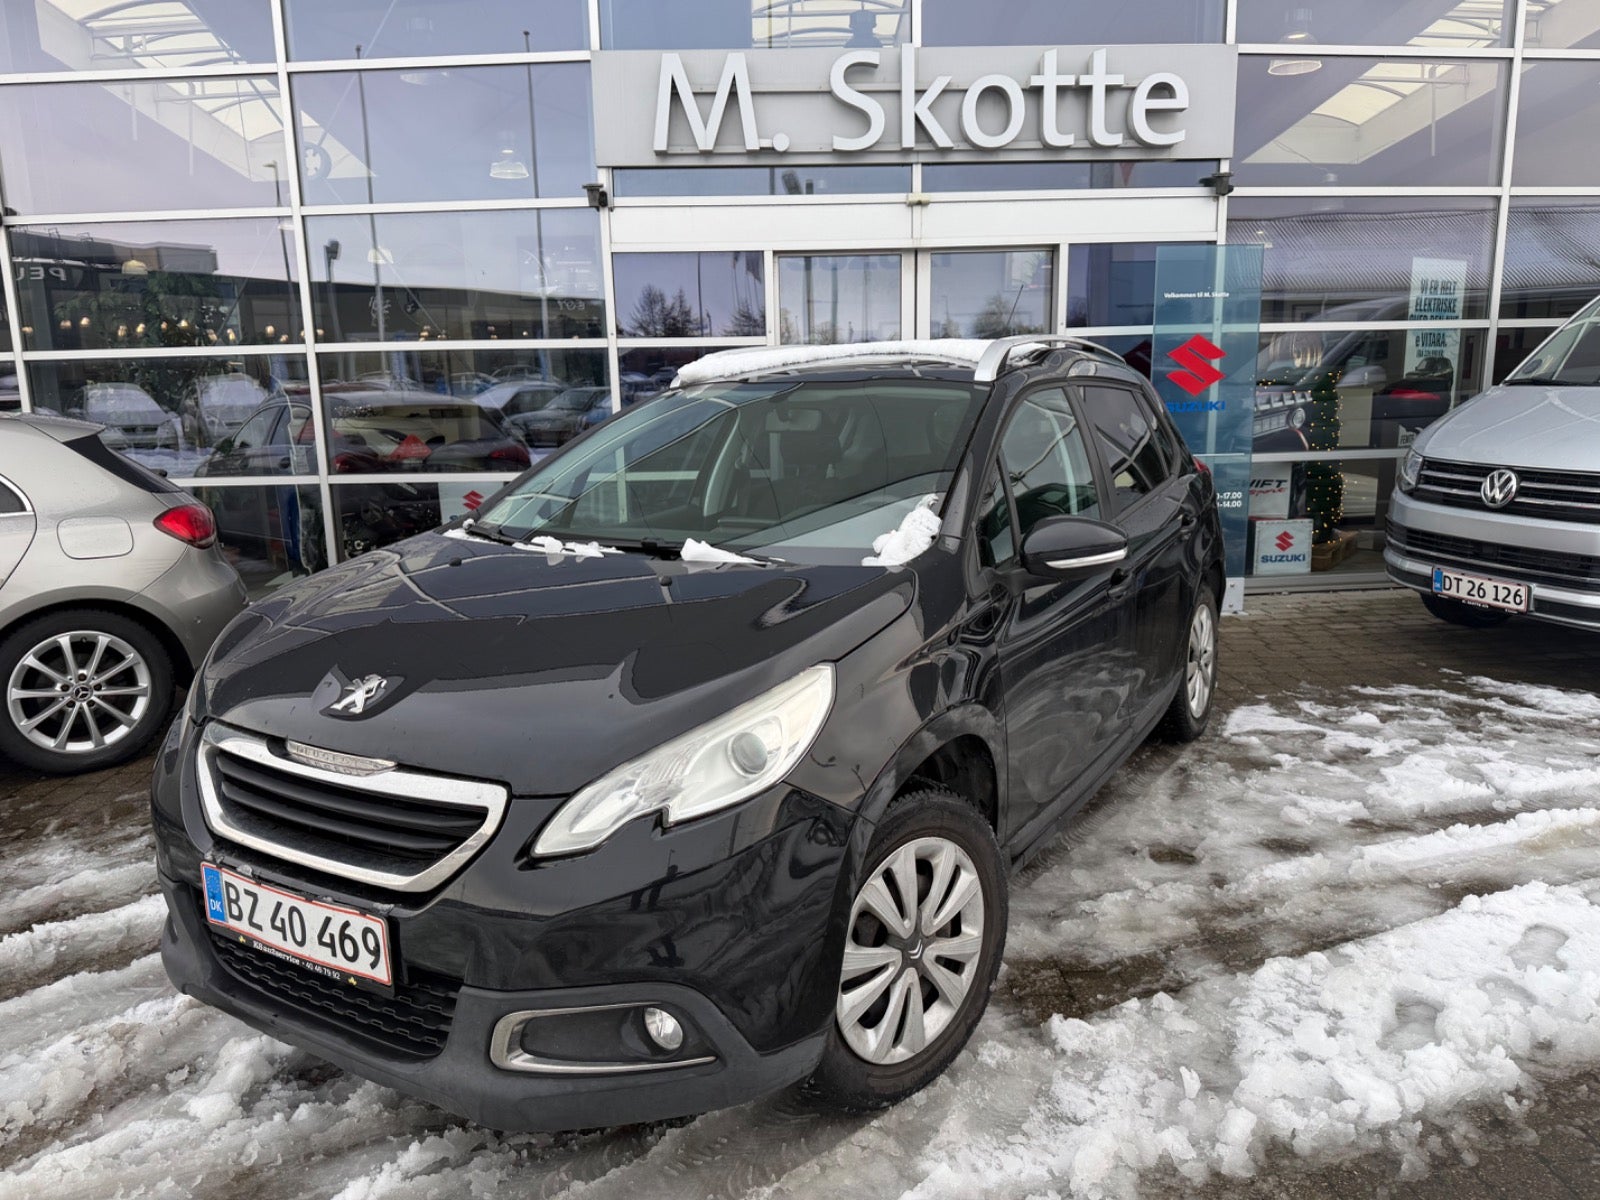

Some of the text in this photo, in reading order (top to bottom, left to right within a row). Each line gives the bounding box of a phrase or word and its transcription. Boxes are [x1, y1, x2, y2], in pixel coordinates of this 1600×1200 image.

[653, 43, 1190, 155] M. Skotte
[1430, 279, 1440, 295] ER
[1440, 281, 1458, 296] HELT
[1415, 296, 1458, 313] ELEKTRISKE
[1166, 400, 1226, 413] SUZUKI
[1260, 553, 1306, 563] SUZUKI
[1443, 574, 1524, 606] DT 26 126
[209, 898, 223, 913] DK
[224, 880, 381, 970] BZ 40 469
